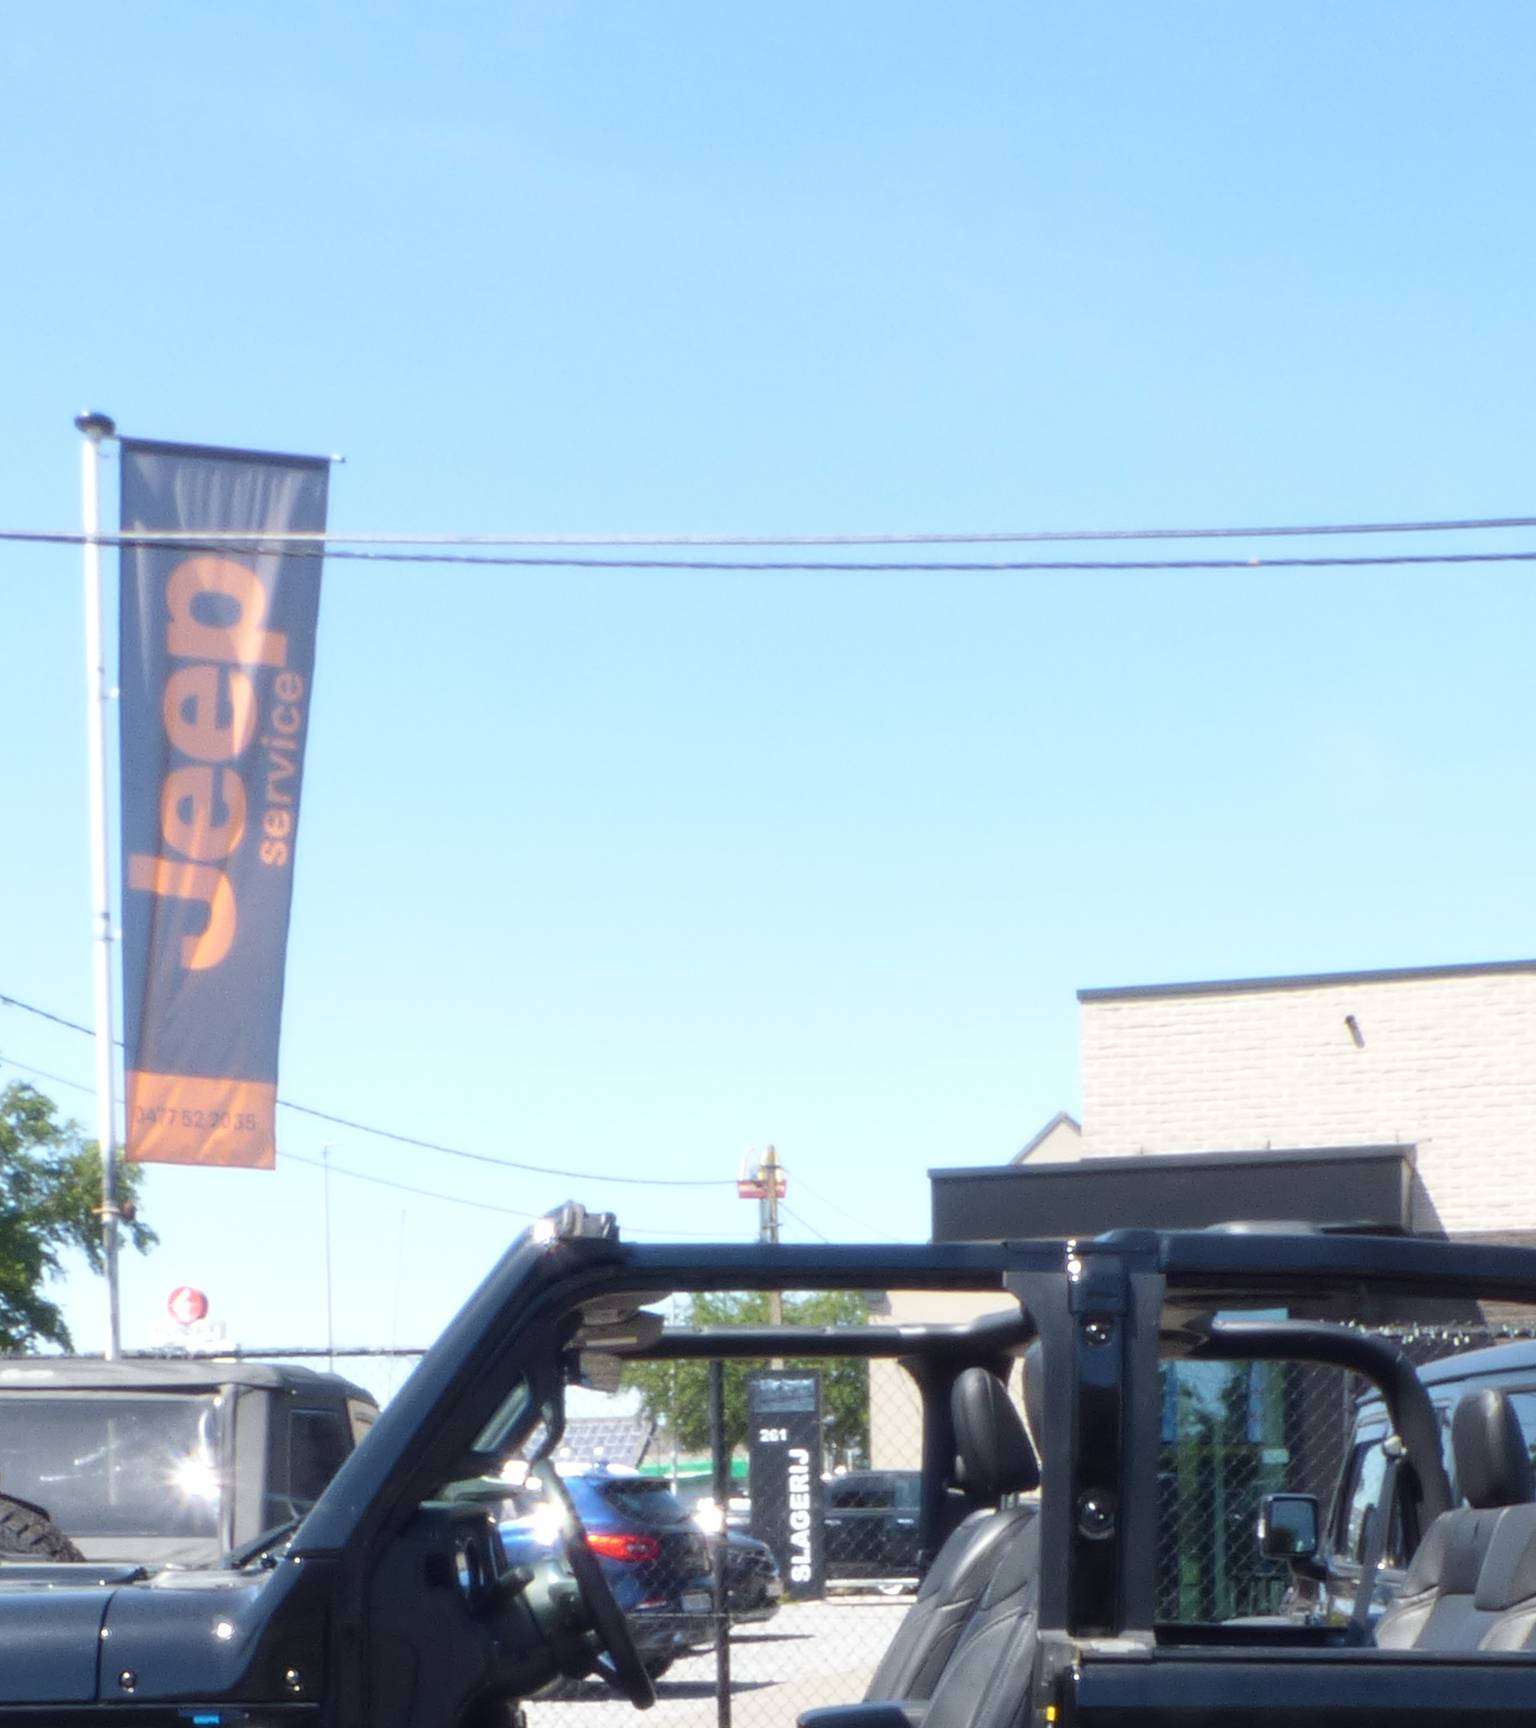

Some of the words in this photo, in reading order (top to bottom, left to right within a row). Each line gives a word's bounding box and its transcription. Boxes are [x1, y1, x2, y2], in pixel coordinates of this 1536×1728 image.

[128, 556, 287, 971] Jeep
[259, 672, 303, 868] service
[788, 1449, 812, 1582] SLAGERIJ
